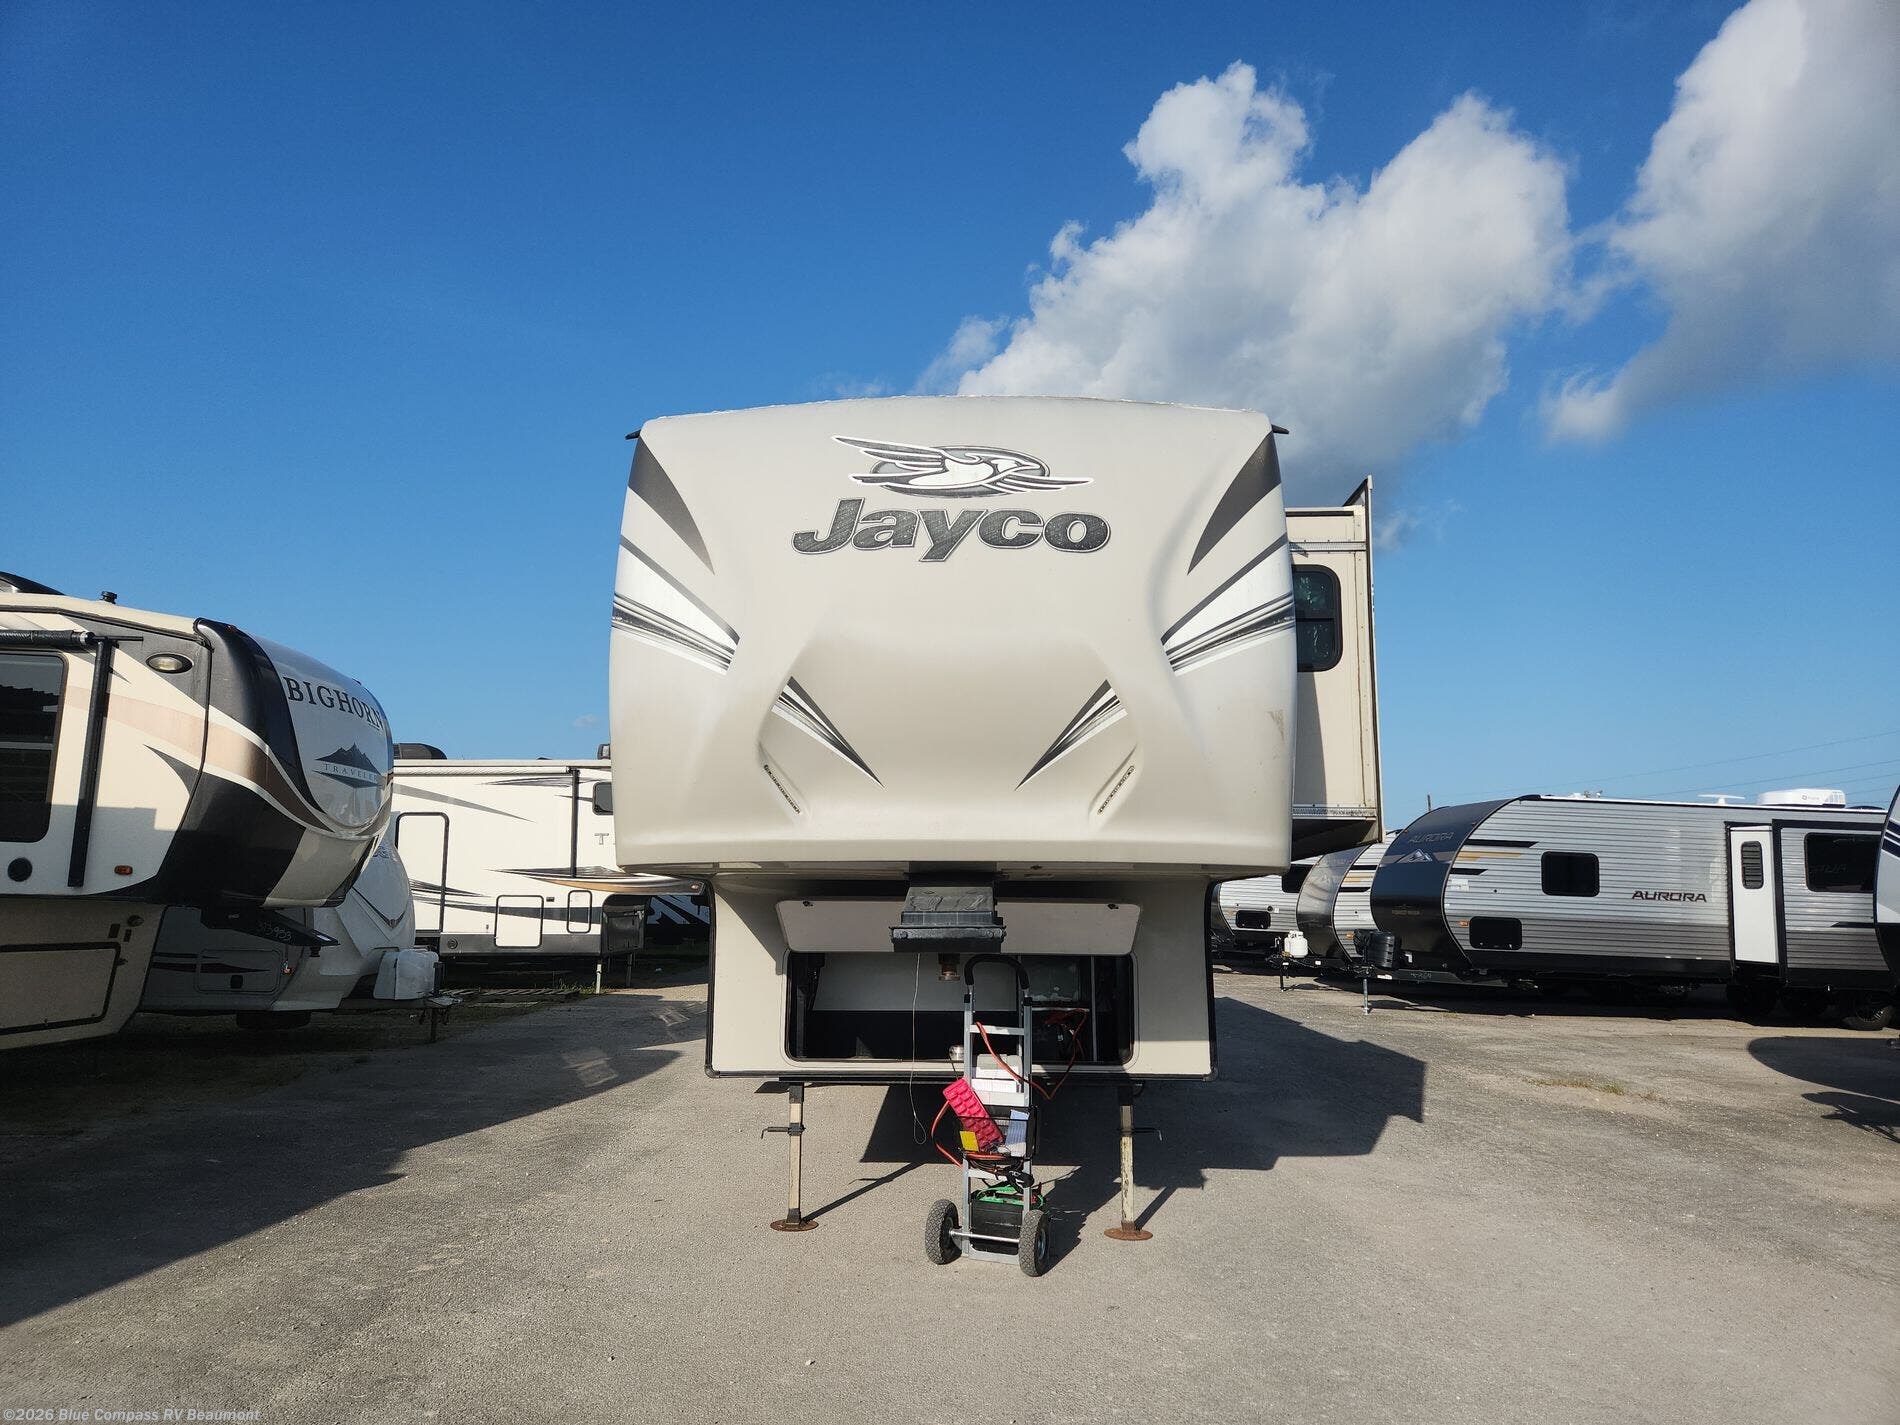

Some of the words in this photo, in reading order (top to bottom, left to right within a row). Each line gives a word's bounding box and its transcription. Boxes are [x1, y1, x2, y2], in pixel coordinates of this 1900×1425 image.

[791, 497, 1112, 562] Jayco
[282, 676, 384, 731] BIGHORN
[1631, 890, 1707, 903] AURORA
